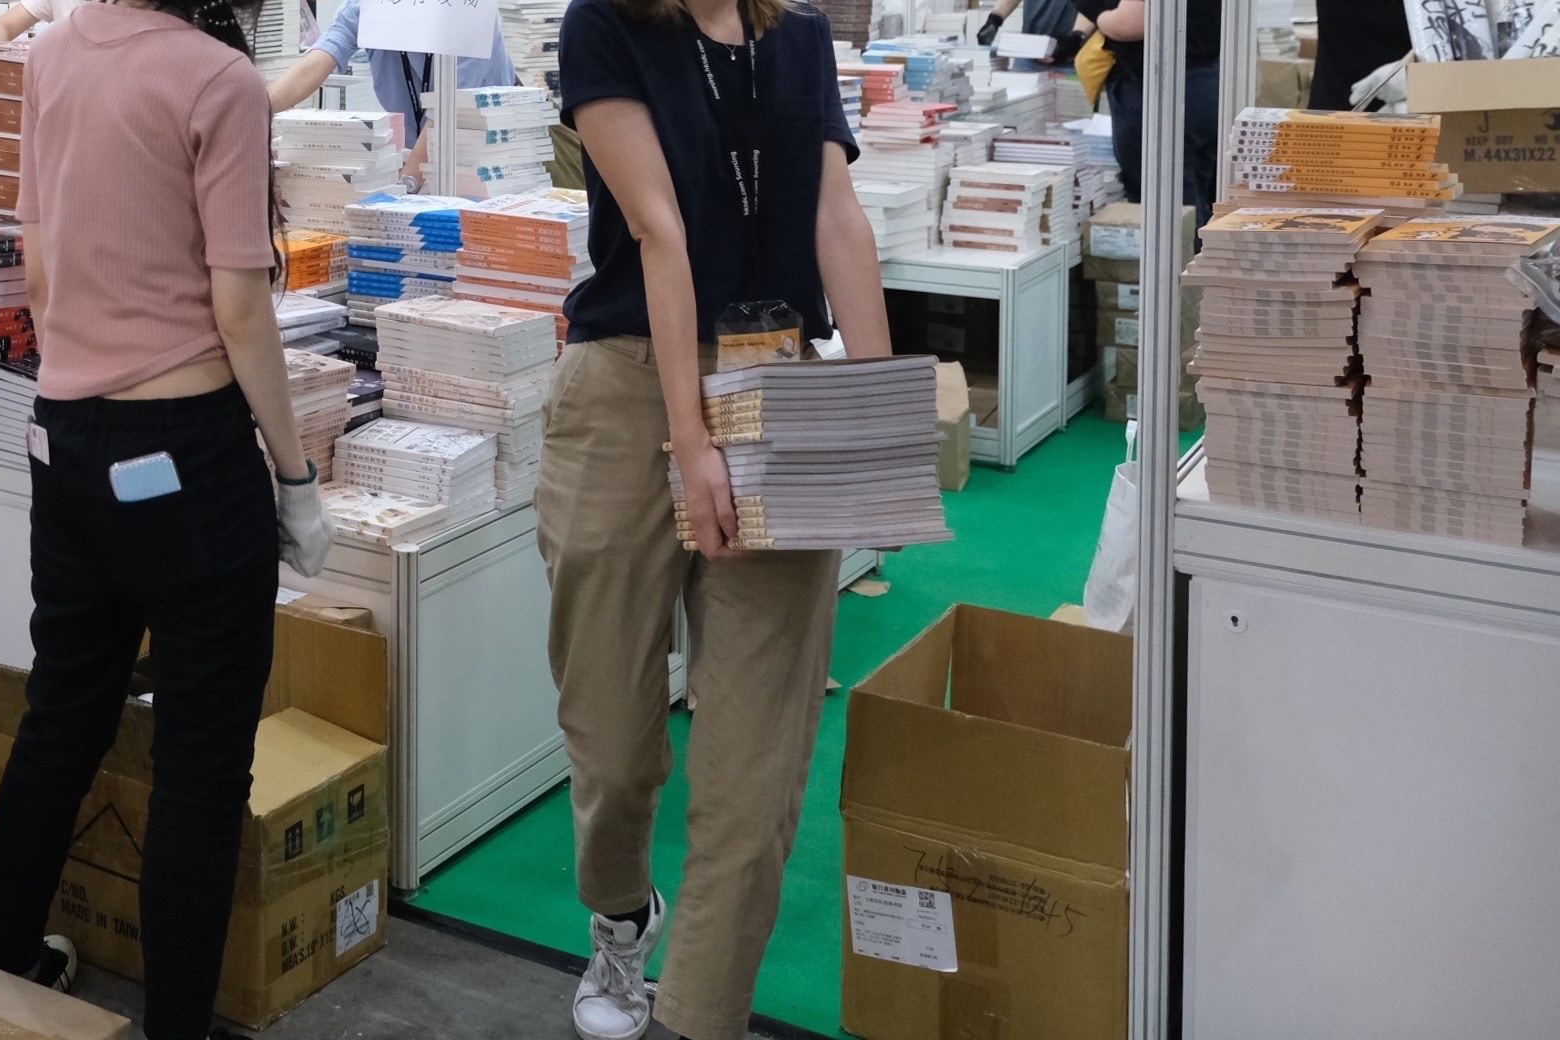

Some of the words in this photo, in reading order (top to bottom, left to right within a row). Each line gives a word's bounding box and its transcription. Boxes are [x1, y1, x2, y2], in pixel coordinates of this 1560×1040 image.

[61, 899, 91, 924] MADE
[95, 911, 108, 930] IN
[113, 918, 141, 942] TAIW
